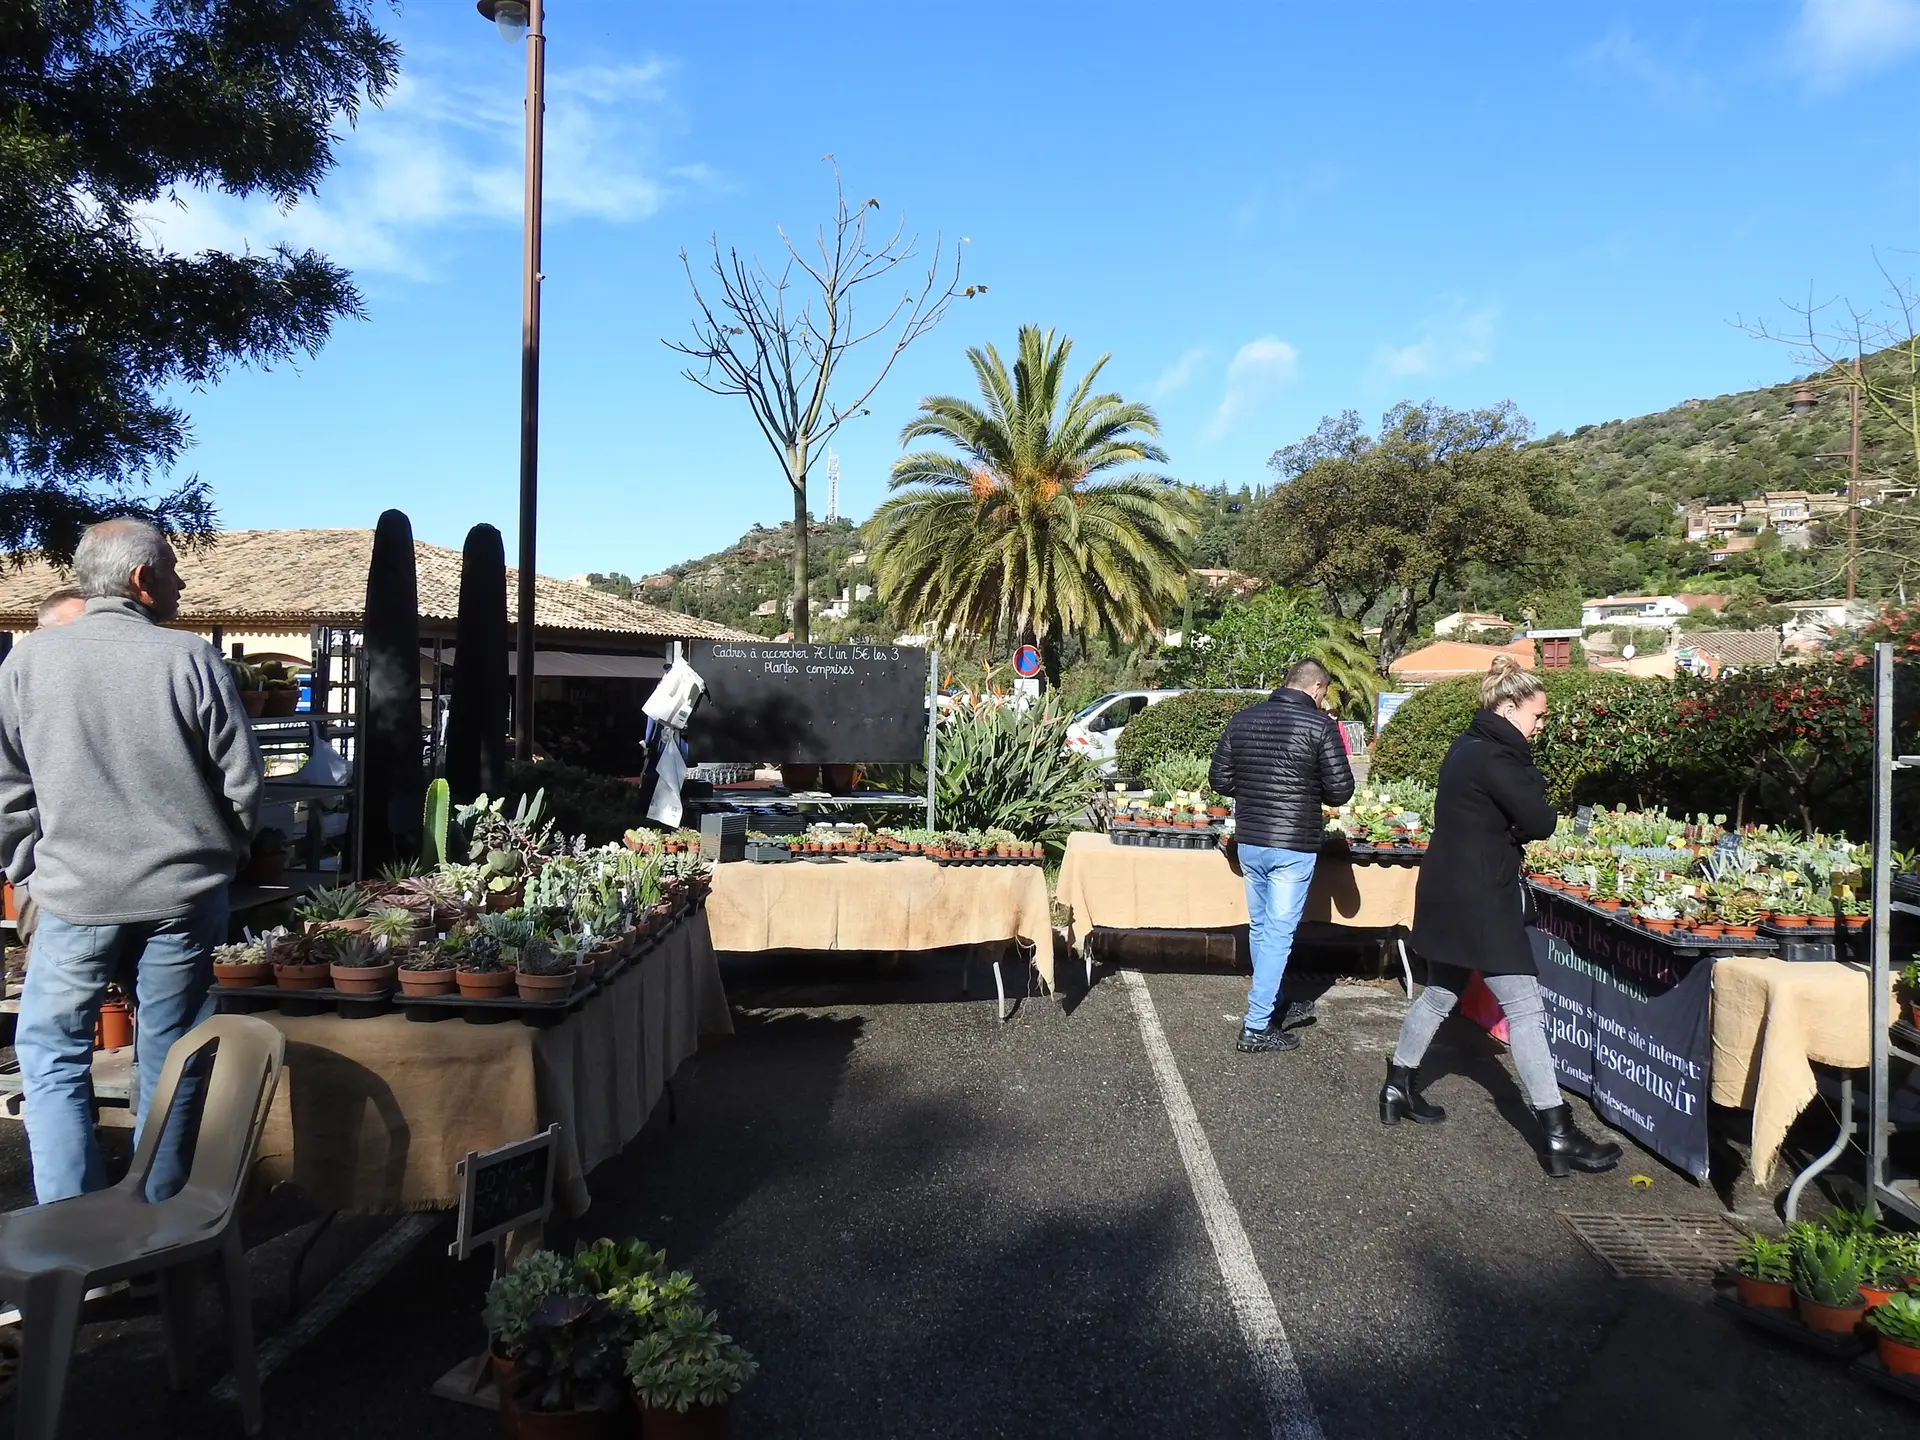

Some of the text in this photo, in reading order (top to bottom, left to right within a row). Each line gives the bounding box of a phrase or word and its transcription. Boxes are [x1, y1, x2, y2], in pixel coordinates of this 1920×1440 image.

[712, 643, 747, 659] Cadres
[750, 647, 757, 659] à
[762, 644, 809, 659] accrocher
[852, 646, 870, 660] 15€
[873, 647, 887, 661] les
[891, 647, 900, 661] 3
[764, 659, 855, 680] Plantes comprises
[1536, 902, 1680, 989] adore les cactus
[1536, 983, 1558, 1005] ouvez
[1559, 994, 1584, 1016] nous
[1598, 1014, 1627, 1040] notre
[1628, 1026, 1647, 1052] site
